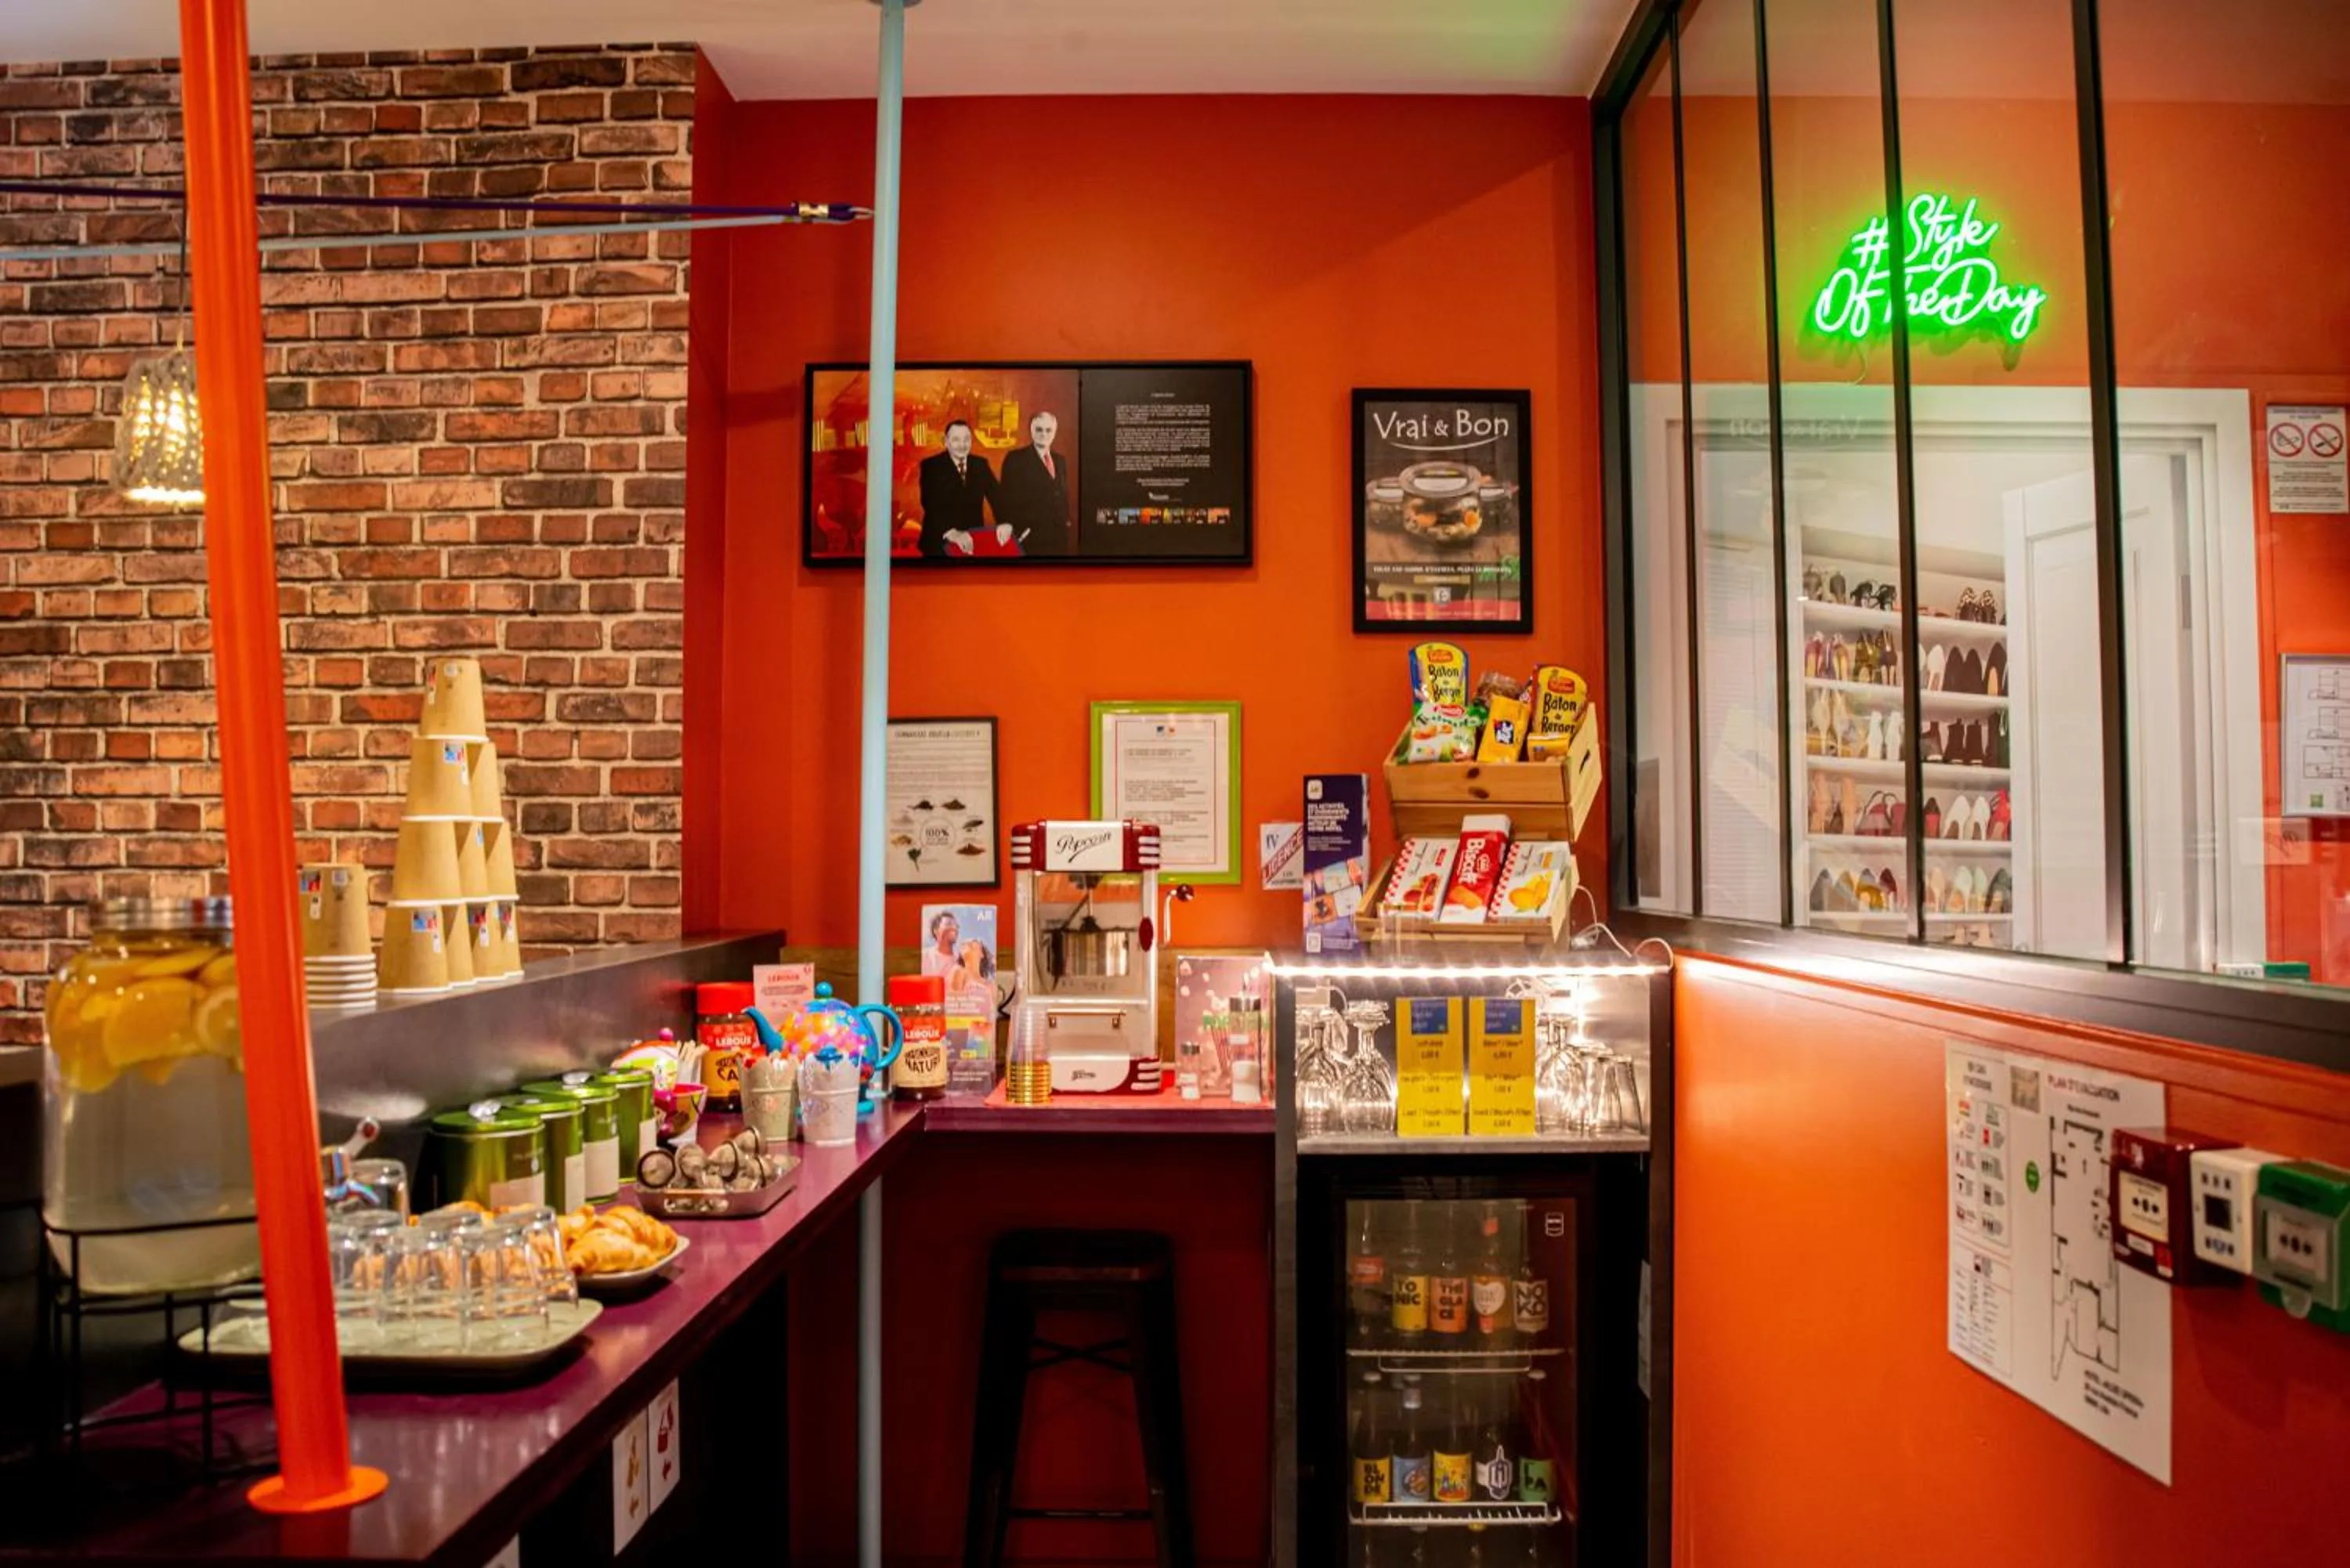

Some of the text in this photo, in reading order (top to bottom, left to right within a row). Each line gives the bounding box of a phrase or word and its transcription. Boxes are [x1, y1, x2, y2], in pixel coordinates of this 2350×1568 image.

[1815, 265, 1889, 338] Of
[1932, 257, 2047, 339] Day
[1373, 408, 1509, 439] Vrai & Bon
[1055, 831, 1112, 863] Popcorn
